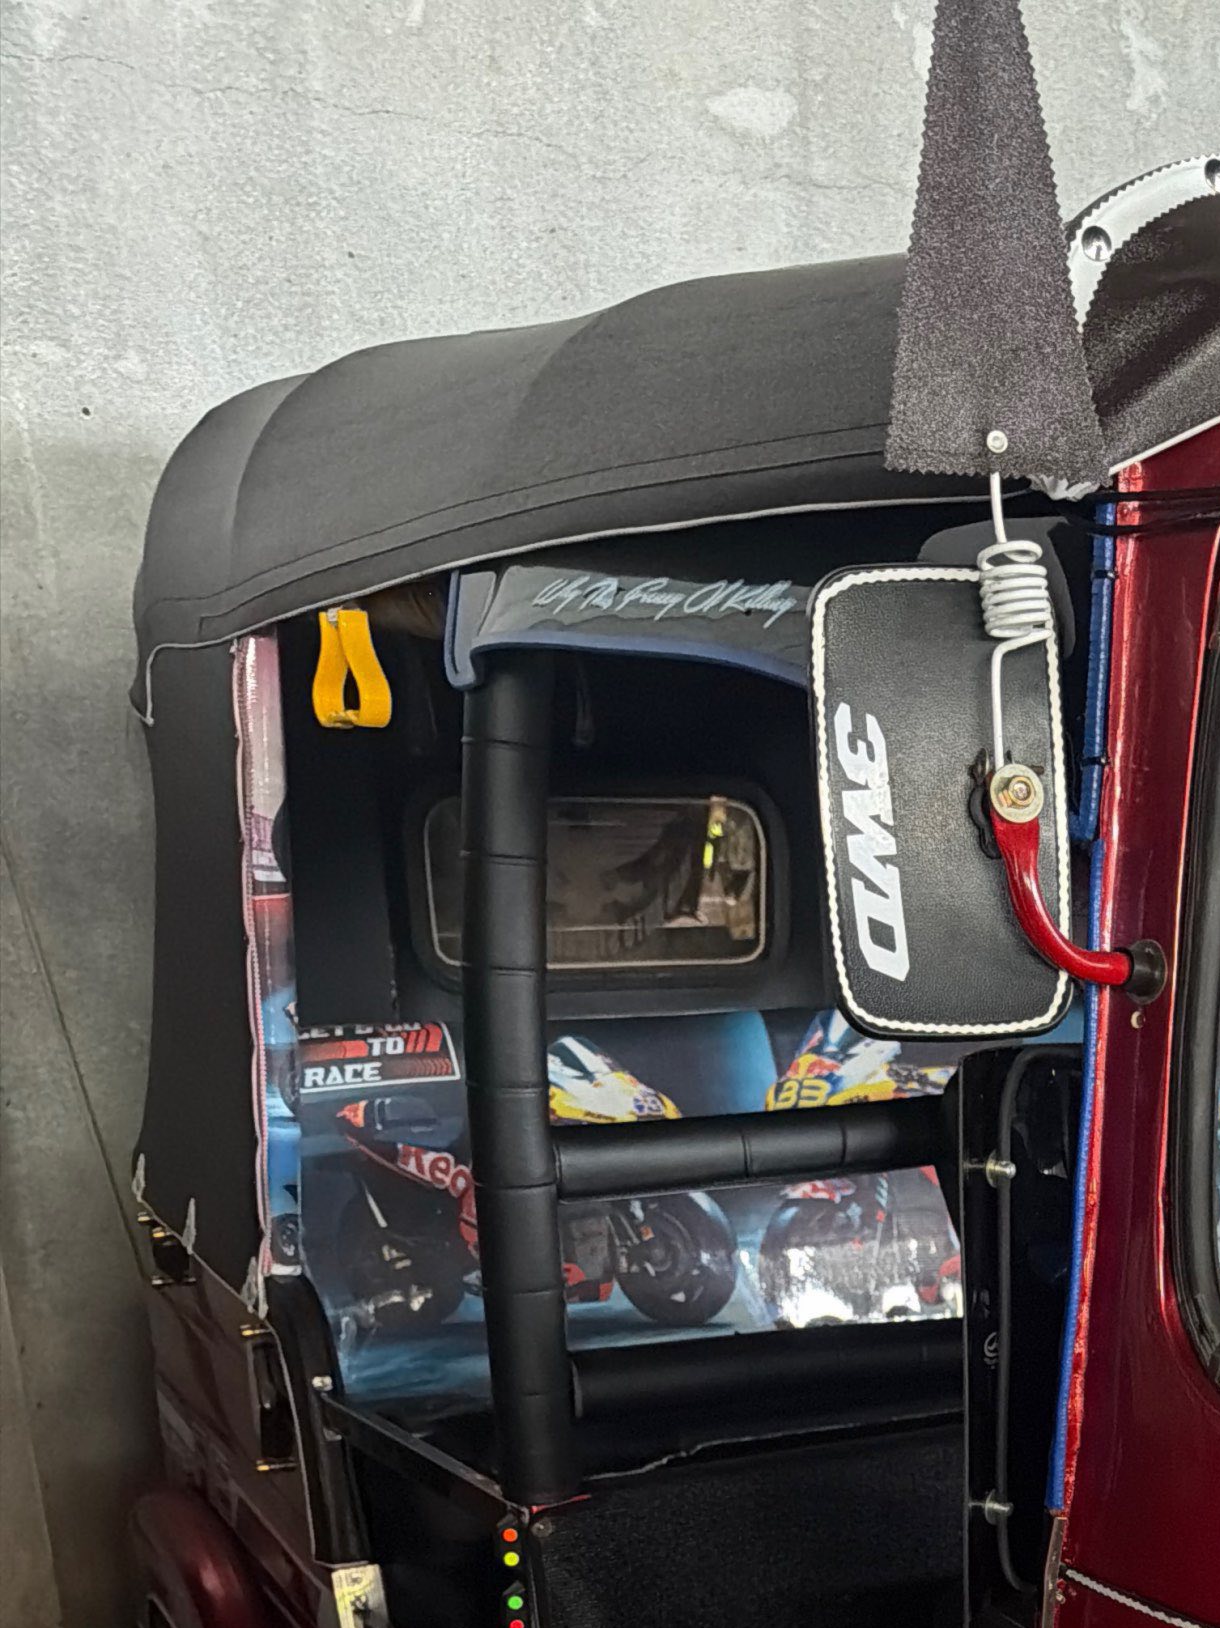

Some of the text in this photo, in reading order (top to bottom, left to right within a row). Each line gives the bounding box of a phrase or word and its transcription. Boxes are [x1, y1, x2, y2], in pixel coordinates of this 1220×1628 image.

[833, 702, 910, 982] 3WD
[366, 1035, 405, 1057] TO
[304, 1061, 383, 1088] RACE
